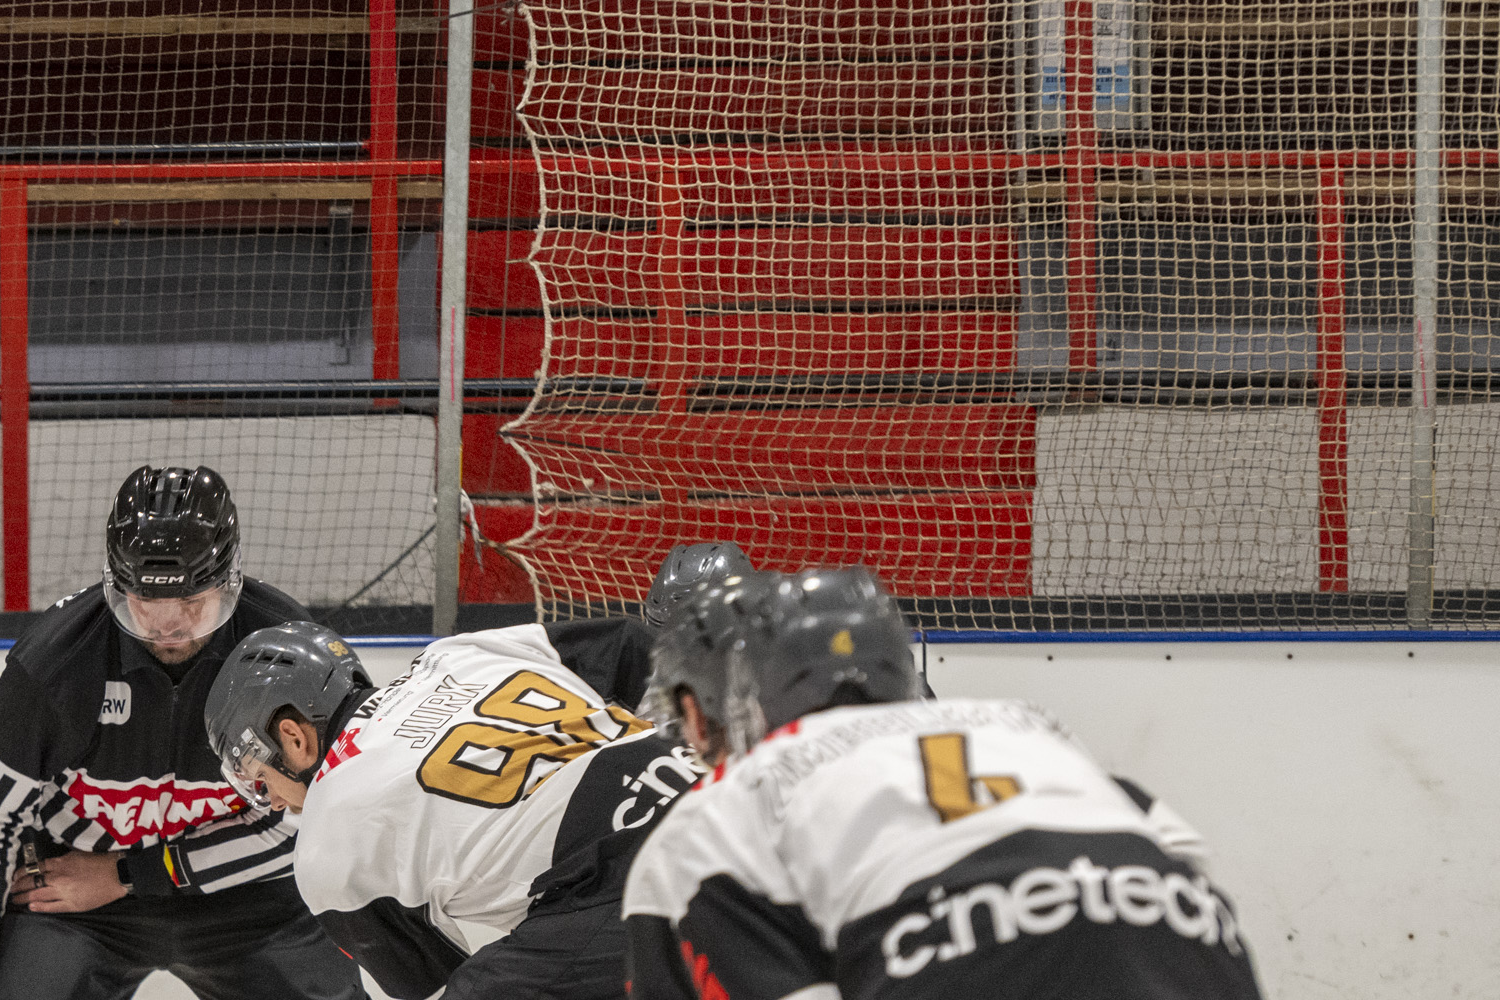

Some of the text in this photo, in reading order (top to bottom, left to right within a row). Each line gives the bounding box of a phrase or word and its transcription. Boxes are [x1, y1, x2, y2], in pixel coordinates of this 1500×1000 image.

[140, 575, 186, 585] CCM
[327, 640, 349, 657] 98
[102, 699, 127, 715] RW
[393, 674, 489, 748] JURK
[612, 743, 710, 833] cine
[83, 791, 240, 837] PENNY
[882, 854, 1243, 978] cinetech
